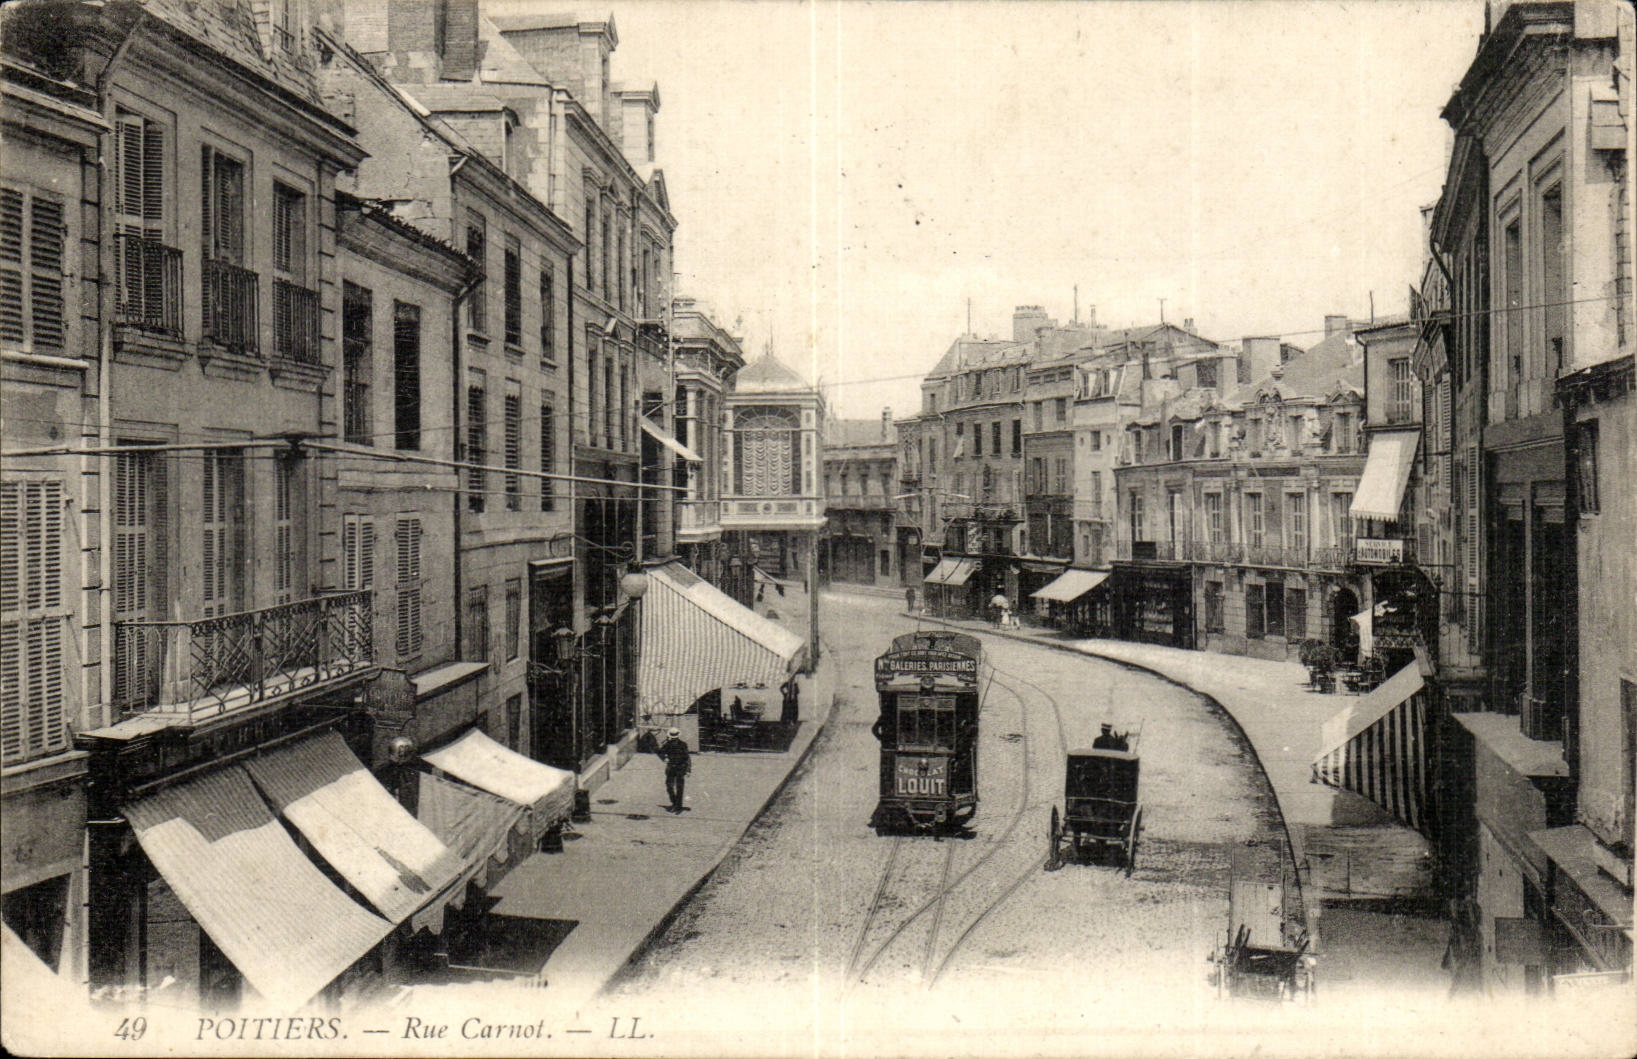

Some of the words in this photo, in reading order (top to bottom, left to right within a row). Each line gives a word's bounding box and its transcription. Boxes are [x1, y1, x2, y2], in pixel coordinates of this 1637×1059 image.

[890, 660, 927, 671] GALERIES
[929, 660, 975, 672] PARISIENNES
[897, 777, 945, 795] LOUIT
